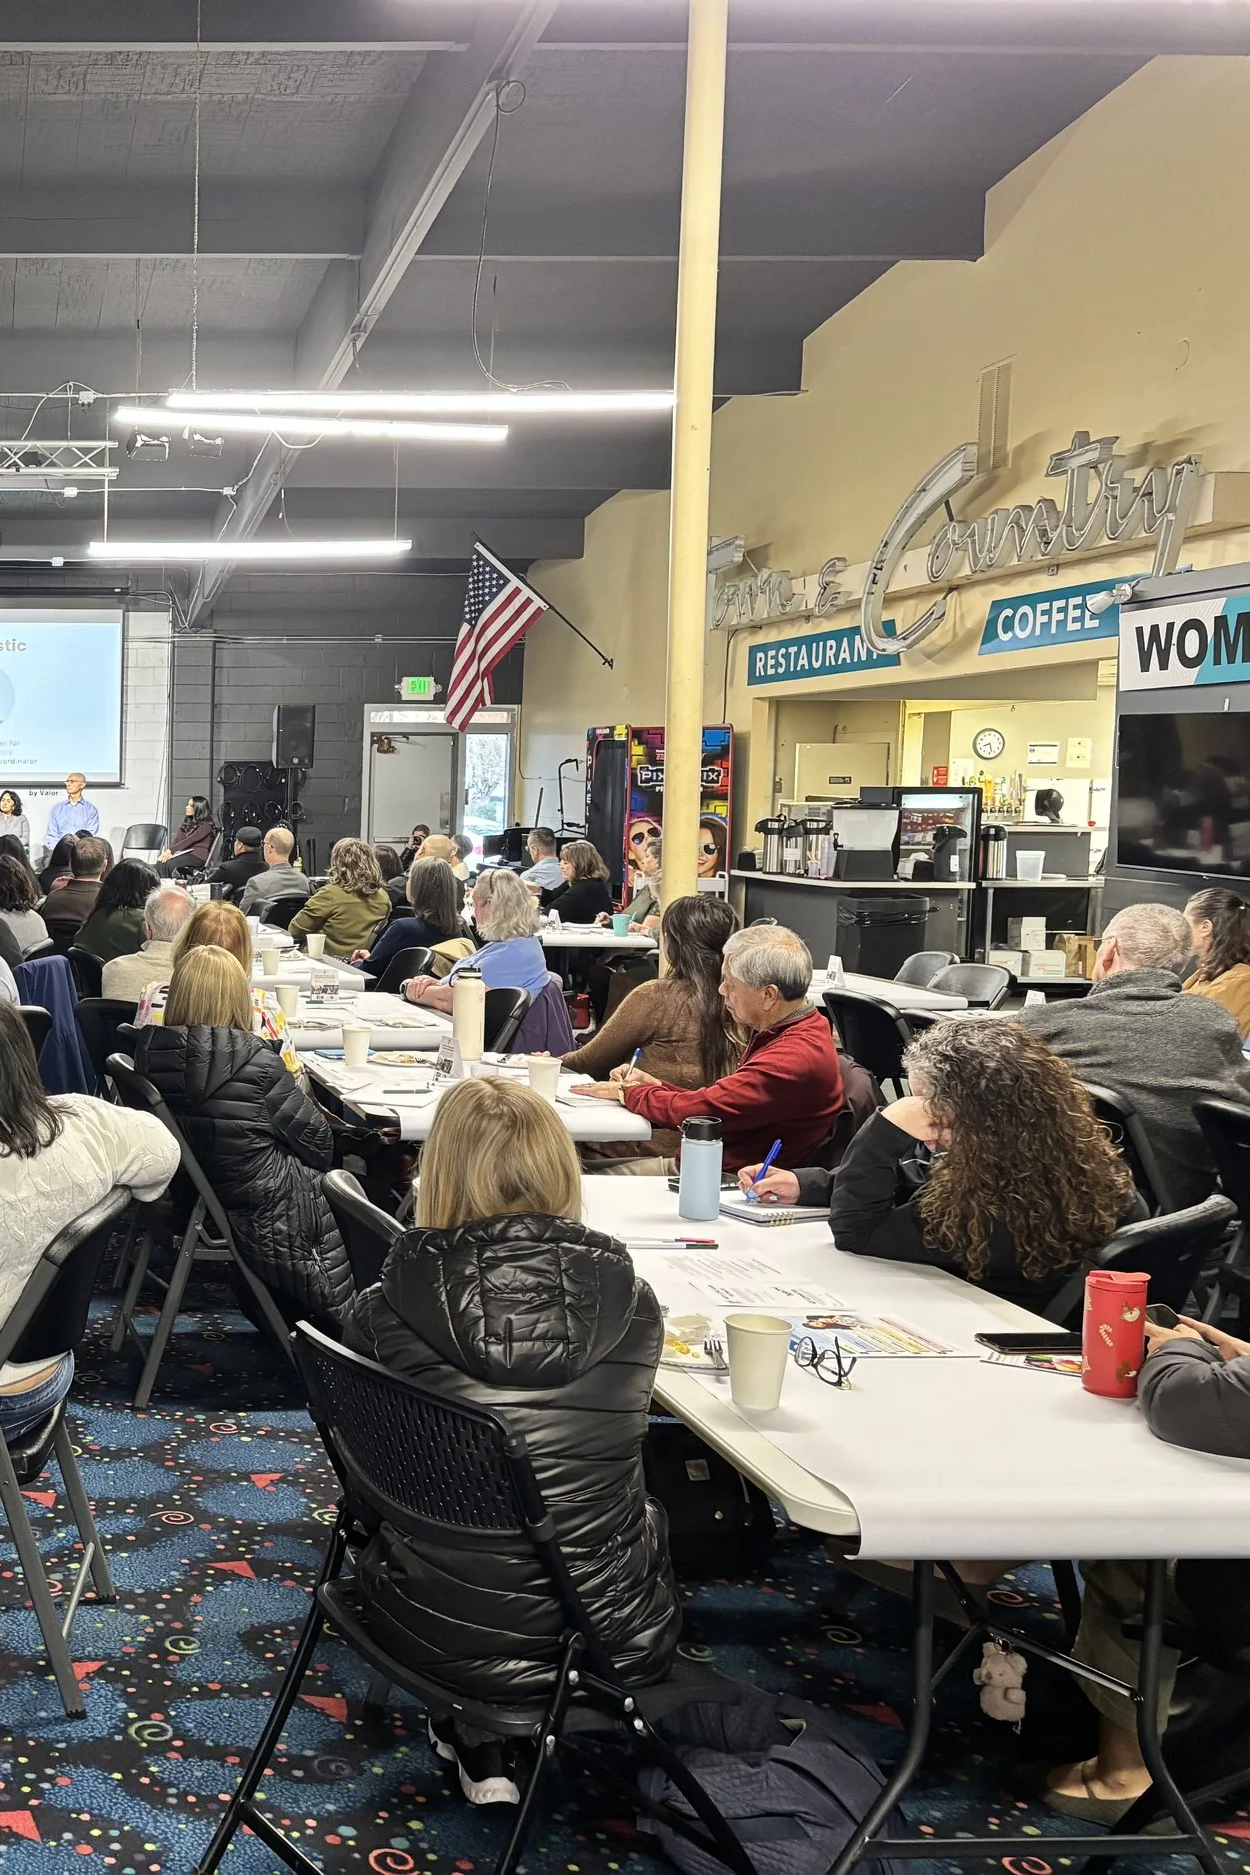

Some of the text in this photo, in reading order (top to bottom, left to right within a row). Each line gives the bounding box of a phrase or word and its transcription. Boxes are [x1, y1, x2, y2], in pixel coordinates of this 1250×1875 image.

[861, 430, 1203, 655] Country
[755, 634, 879, 677] RESTAURAN
[410, 679, 431, 694] EXIT
[9, 739, 21, 747] for
[40, 789, 59, 797] Valor
